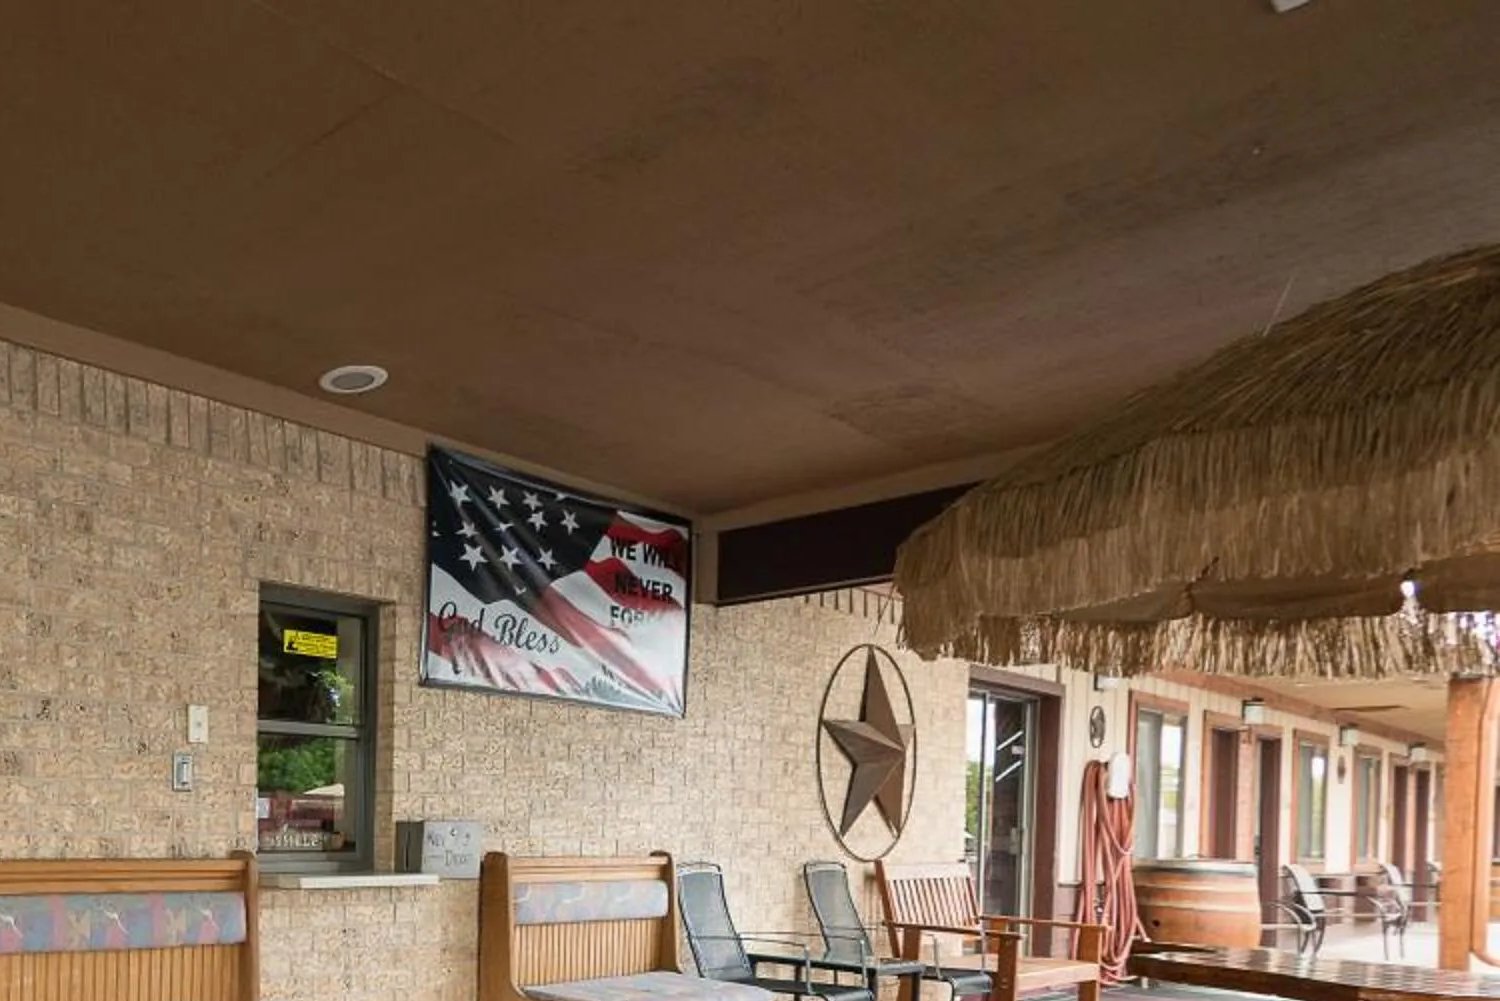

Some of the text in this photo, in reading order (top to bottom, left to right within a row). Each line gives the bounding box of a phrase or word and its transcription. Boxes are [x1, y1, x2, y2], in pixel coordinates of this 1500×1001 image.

[611, 537, 637, 561] WE
[614, 572, 674, 602] NEVER
[493, 613, 560, 655] Bless
